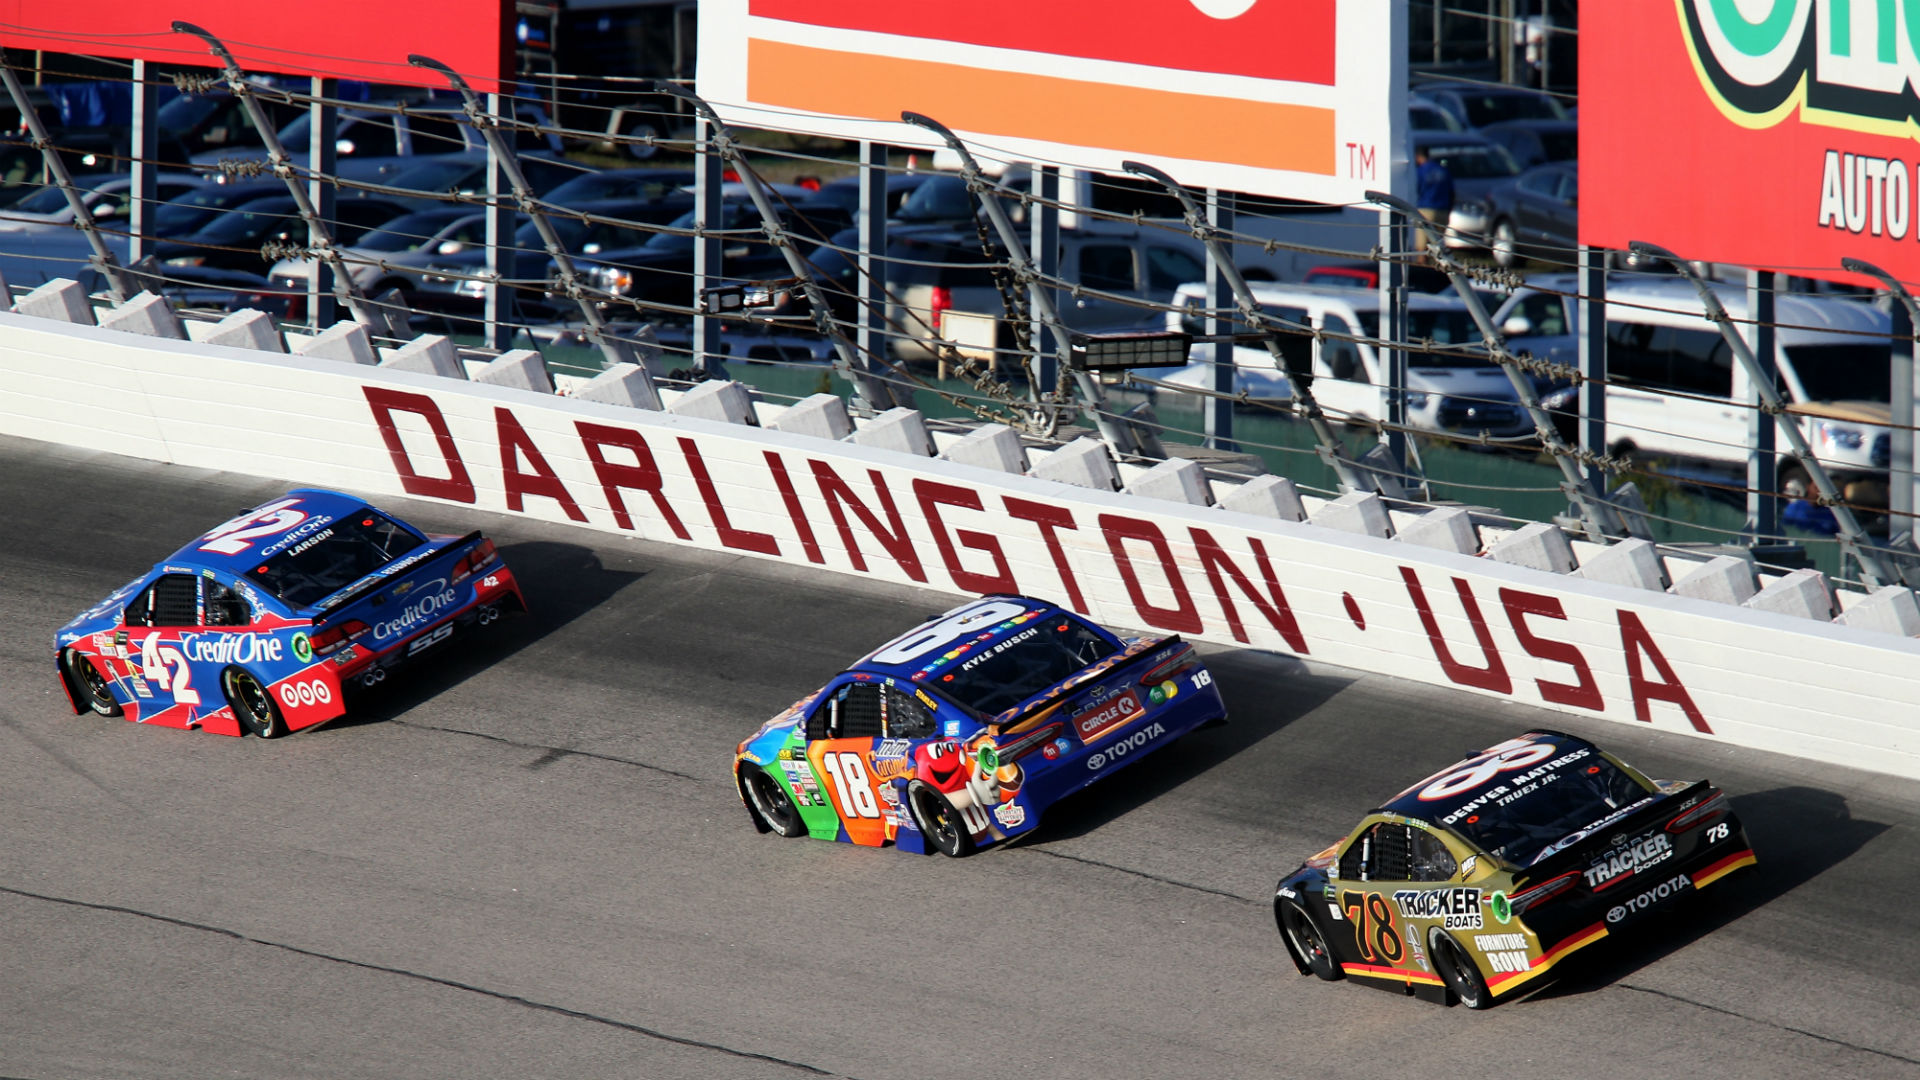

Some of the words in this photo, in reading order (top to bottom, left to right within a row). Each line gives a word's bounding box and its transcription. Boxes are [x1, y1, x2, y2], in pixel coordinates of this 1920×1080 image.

[1346, 143, 1376, 181] TM
[1818, 149, 1909, 241] AUTO
[287, 529, 334, 557] LARSON
[362, 386, 1309, 654] DARLINGTON
[1400, 567, 1713, 734] USA
[483, 576, 499, 587] 42
[373, 588, 455, 640] CreditOne
[183, 632, 283, 663] CreditOne
[962, 649, 994, 671] KYLE
[993, 627, 1038, 653] BUSCH
[142, 631, 200, 705] 42
[1190, 669, 1212, 690] 18
[1081, 706, 1118, 732] CIRCLE
[1119, 697, 1134, 714] K
[1104, 722, 1165, 760] TOYOTA
[824, 752, 880, 818] 18
[1443, 785, 1510, 825] DENVER
[1512, 748, 1590, 786] MATTRESS
[1496, 784, 1540, 807] TRUEX
[1542, 774, 1561, 786] JR.
[1583, 797, 1653, 830] TRACKER
[1706, 823, 1729, 843] 78
[1634, 850, 1673, 875] boats
[1393, 888, 1482, 919] TRACKER
[1625, 874, 1692, 913] TOYOTA
[1342, 888, 1406, 965] 78
[1445, 915, 1483, 930] BOATS
[1474, 934, 1528, 952] FURNITURE
[1487, 951, 1531, 972] ROW
